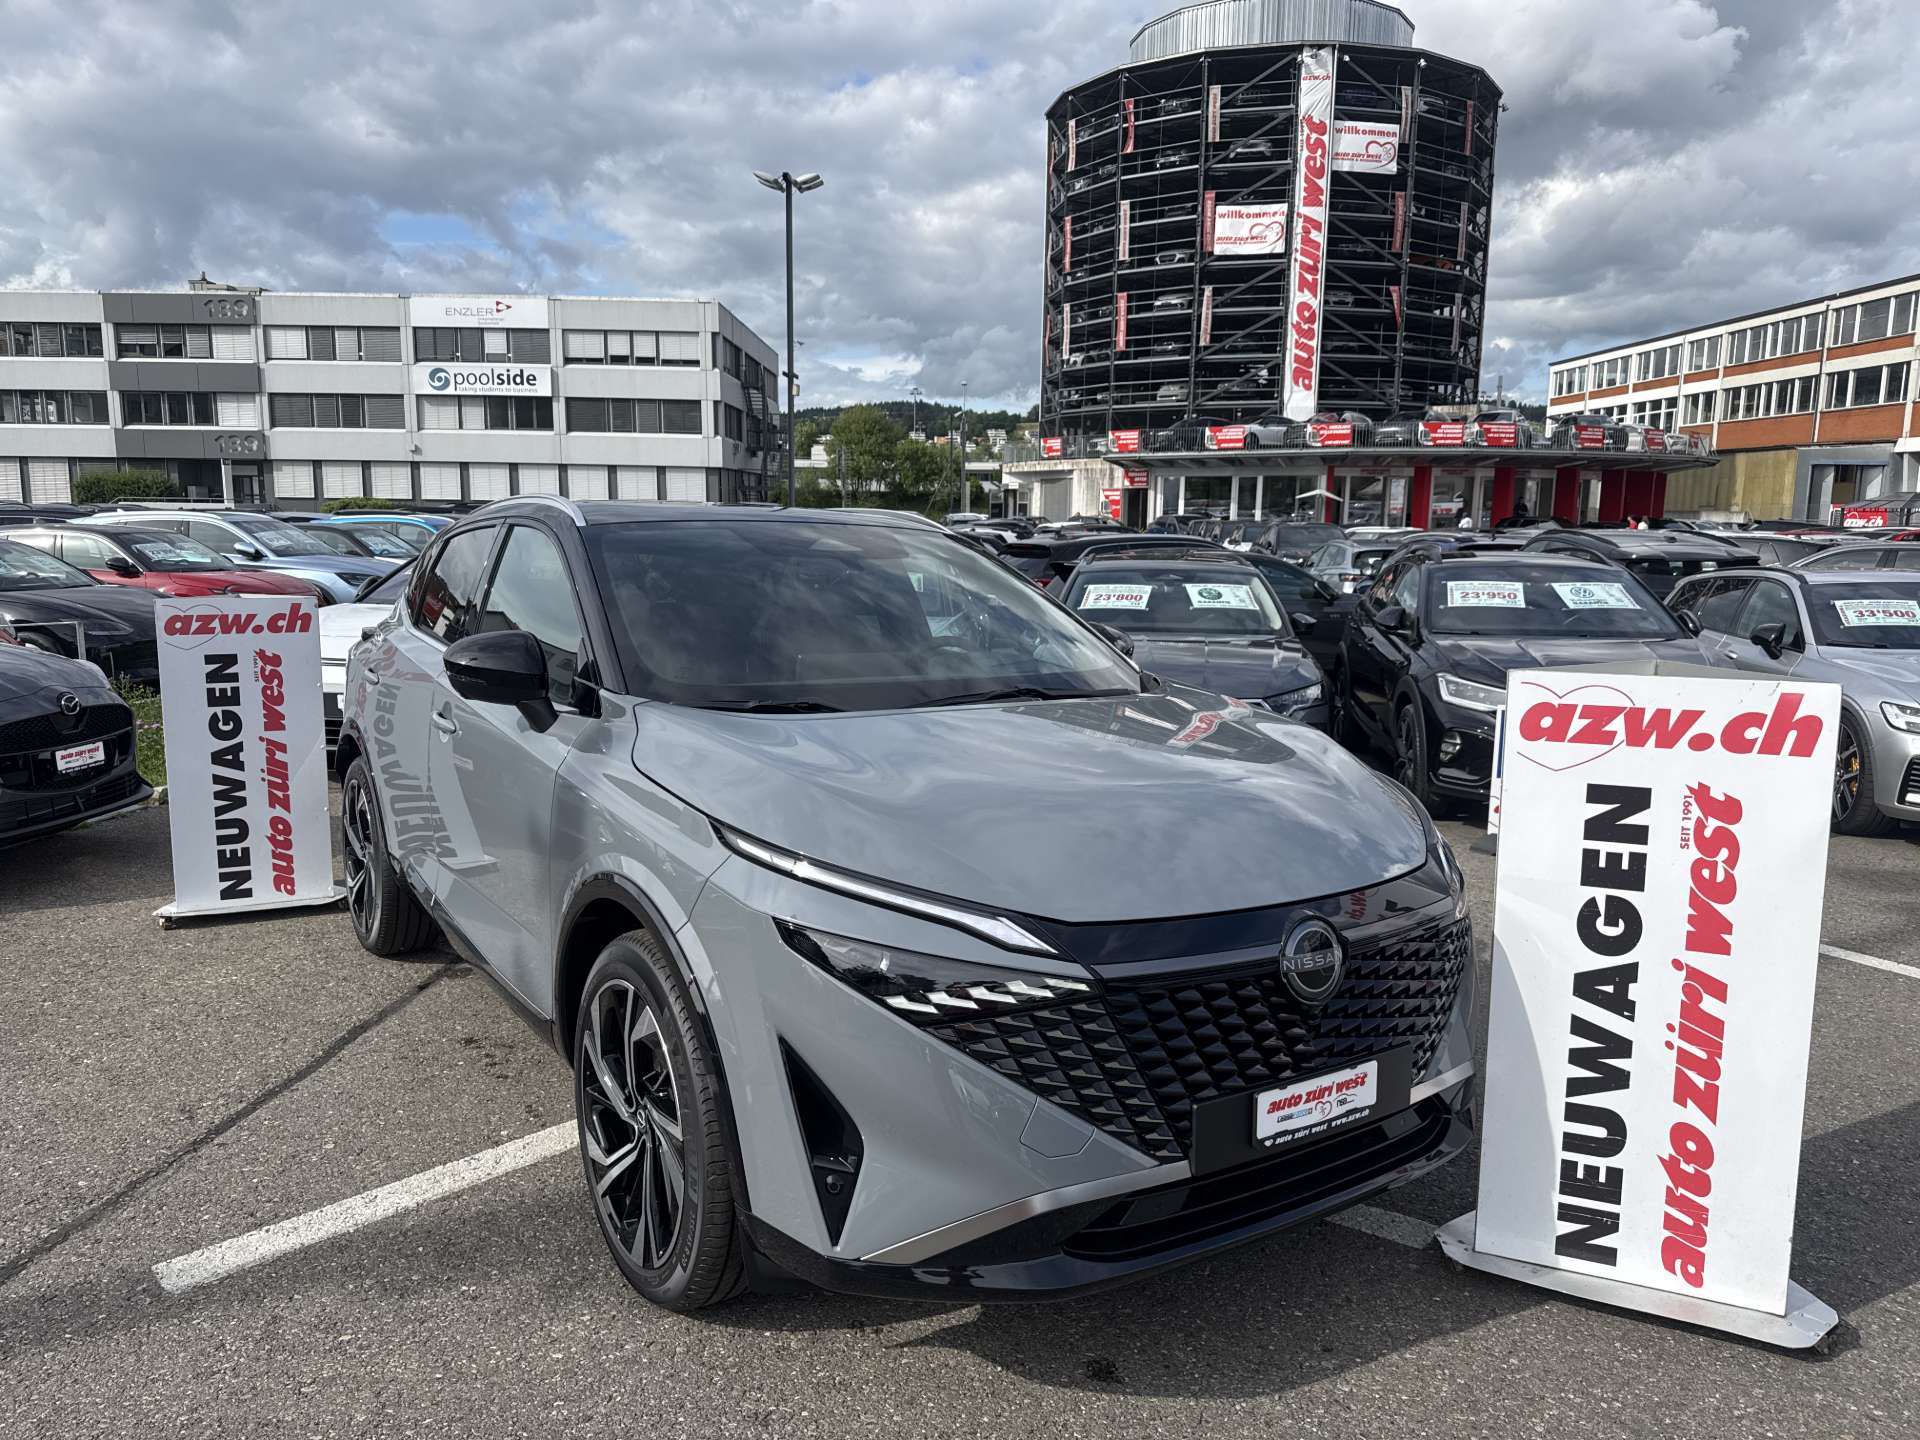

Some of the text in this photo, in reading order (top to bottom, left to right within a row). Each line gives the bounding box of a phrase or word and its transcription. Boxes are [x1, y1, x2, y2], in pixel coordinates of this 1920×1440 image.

[1335, 126, 1397, 138] willkommen
[1218, 210, 1286, 219] willkommen
[1291, 114, 1329, 391] auto züri west
[204, 299, 249, 319] 139
[445, 307, 494, 317] ENZLER
[453, 368, 537, 391] poolside
[214, 434, 258, 454] 139
[1843, 516, 1884, 527] azw.ch
[1093, 593, 1144, 602] 23'800
[1459, 591, 1518, 601] 23'950
[164, 603, 312, 636] azw.ch
[1519, 692, 1824, 758] azw.ch
[204, 653, 253, 901] NEUWAGEN
[254, 649, 296, 896] auto züri west
[1680, 794, 1693, 849] SEIT 1991
[1283, 952, 1342, 971] NISSA
[1555, 783, 1652, 1267] NEUWAGEN
[1656, 780, 1743, 1289] auto züri west
[1267, 1094, 1303, 1114] auto
[1303, 1081, 1335, 1105] züri
[1336, 1072, 1368, 1096] west
[1275, 1134, 1293, 1144] auto
[1311, 1124, 1328, 1133] west
